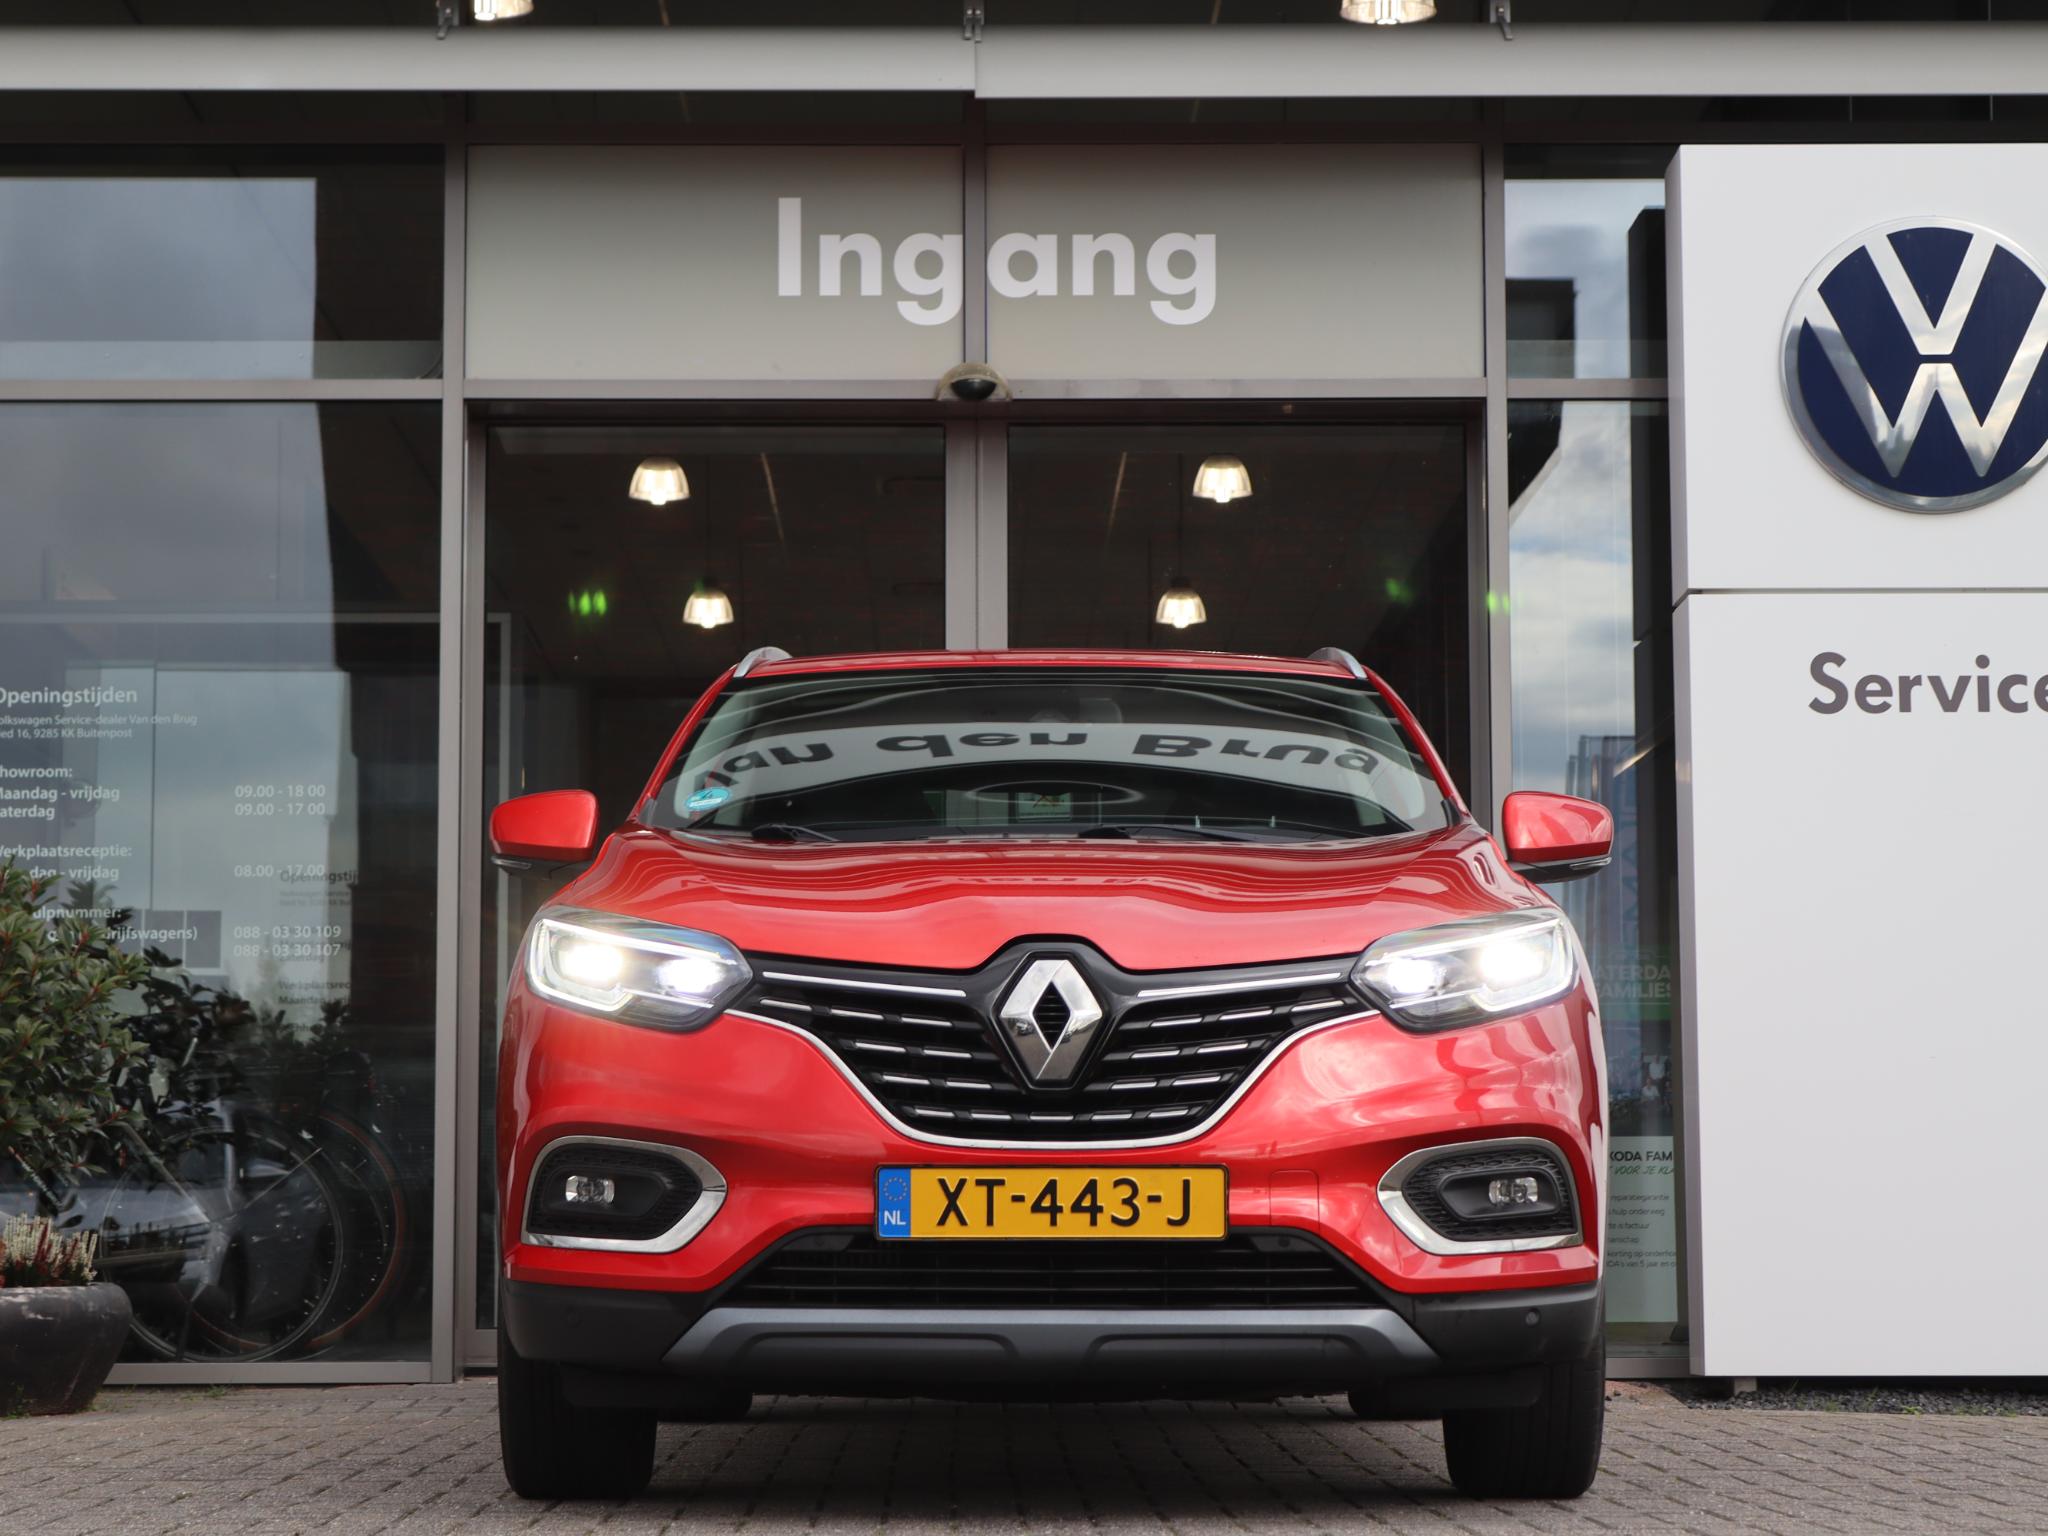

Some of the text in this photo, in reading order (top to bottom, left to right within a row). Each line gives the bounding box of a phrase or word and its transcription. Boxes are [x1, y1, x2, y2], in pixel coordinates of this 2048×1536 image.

[778, 197, 1216, 326] Ingang
[54, 714, 127, 725] Service-dealer
[129, 714, 148, 724] Van
[151, 714, 171, 725] den
[173, 713, 198, 727] Brug
[34, 728, 59, 738] 9285
[61, 728, 75, 738] KK
[77, 728, 133, 740] Buitenpost
[70, 786, 120, 802] vrijdag
[68, 866, 119, 882] vrijdag
[234, 927, 260, 938] 088
[272, 926, 290, 938] 03
[294, 926, 311, 938] 30
[316, 926, 342, 938] 109
[272, 944, 290, 957] 03
[294, 944, 311, 957] 30
[316, 944, 341, 957] 107
[1646, 1151, 1673, 1161] FAM
[1614, 1165, 1640, 1175] VOOR
[936, 1178, 1192, 1227] XT-443-J
[883, 1210, 906, 1225] NL
